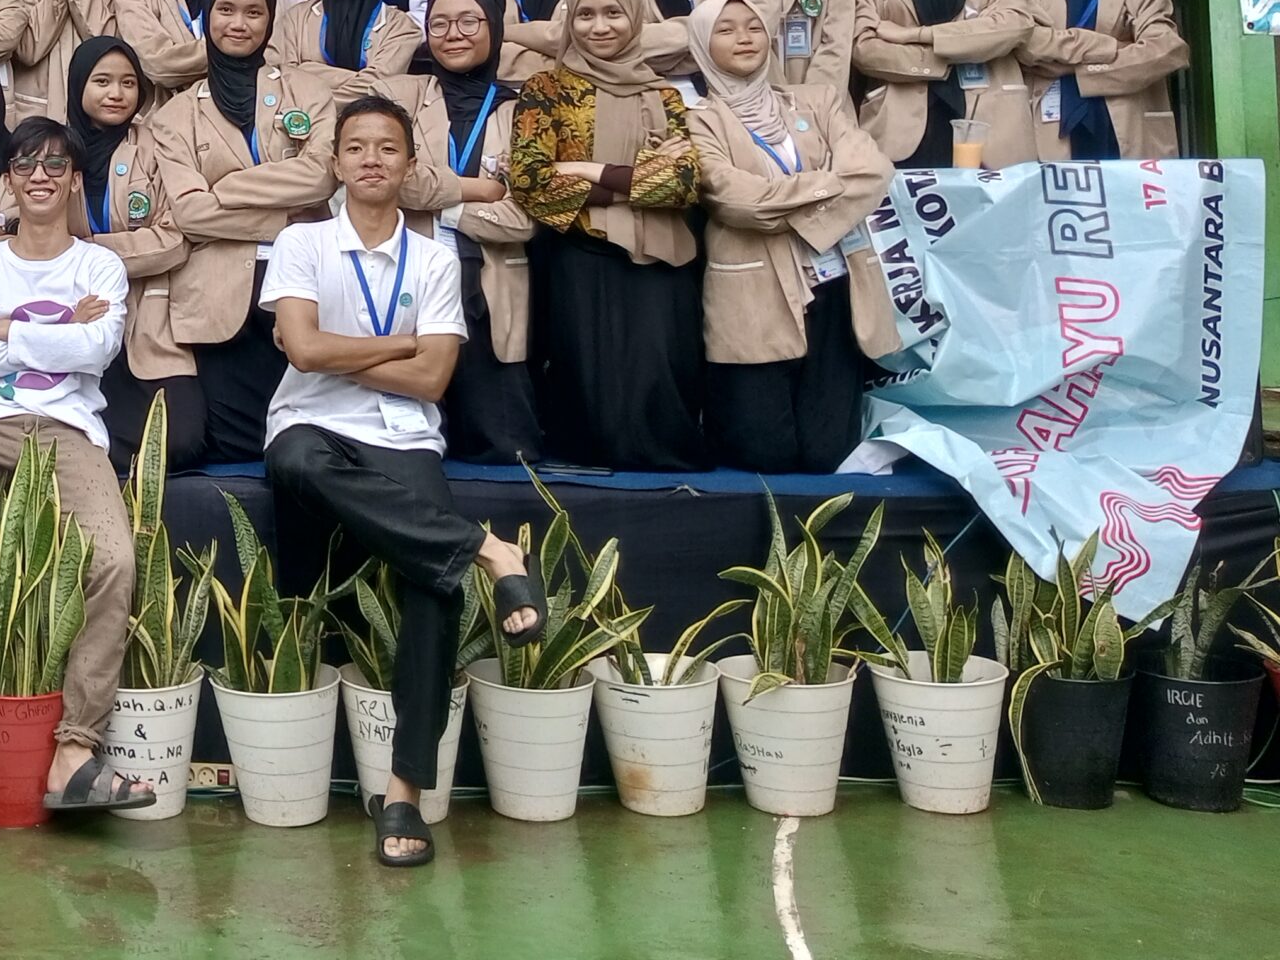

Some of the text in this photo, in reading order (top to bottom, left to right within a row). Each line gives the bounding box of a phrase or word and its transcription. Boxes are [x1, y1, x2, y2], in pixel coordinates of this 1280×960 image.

[1143, 183, 1168, 210] 17
[879, 238, 945, 334] KERJA
[1196, 194, 1224, 409] NUSANTARA
[134, 723, 148, 740] &
